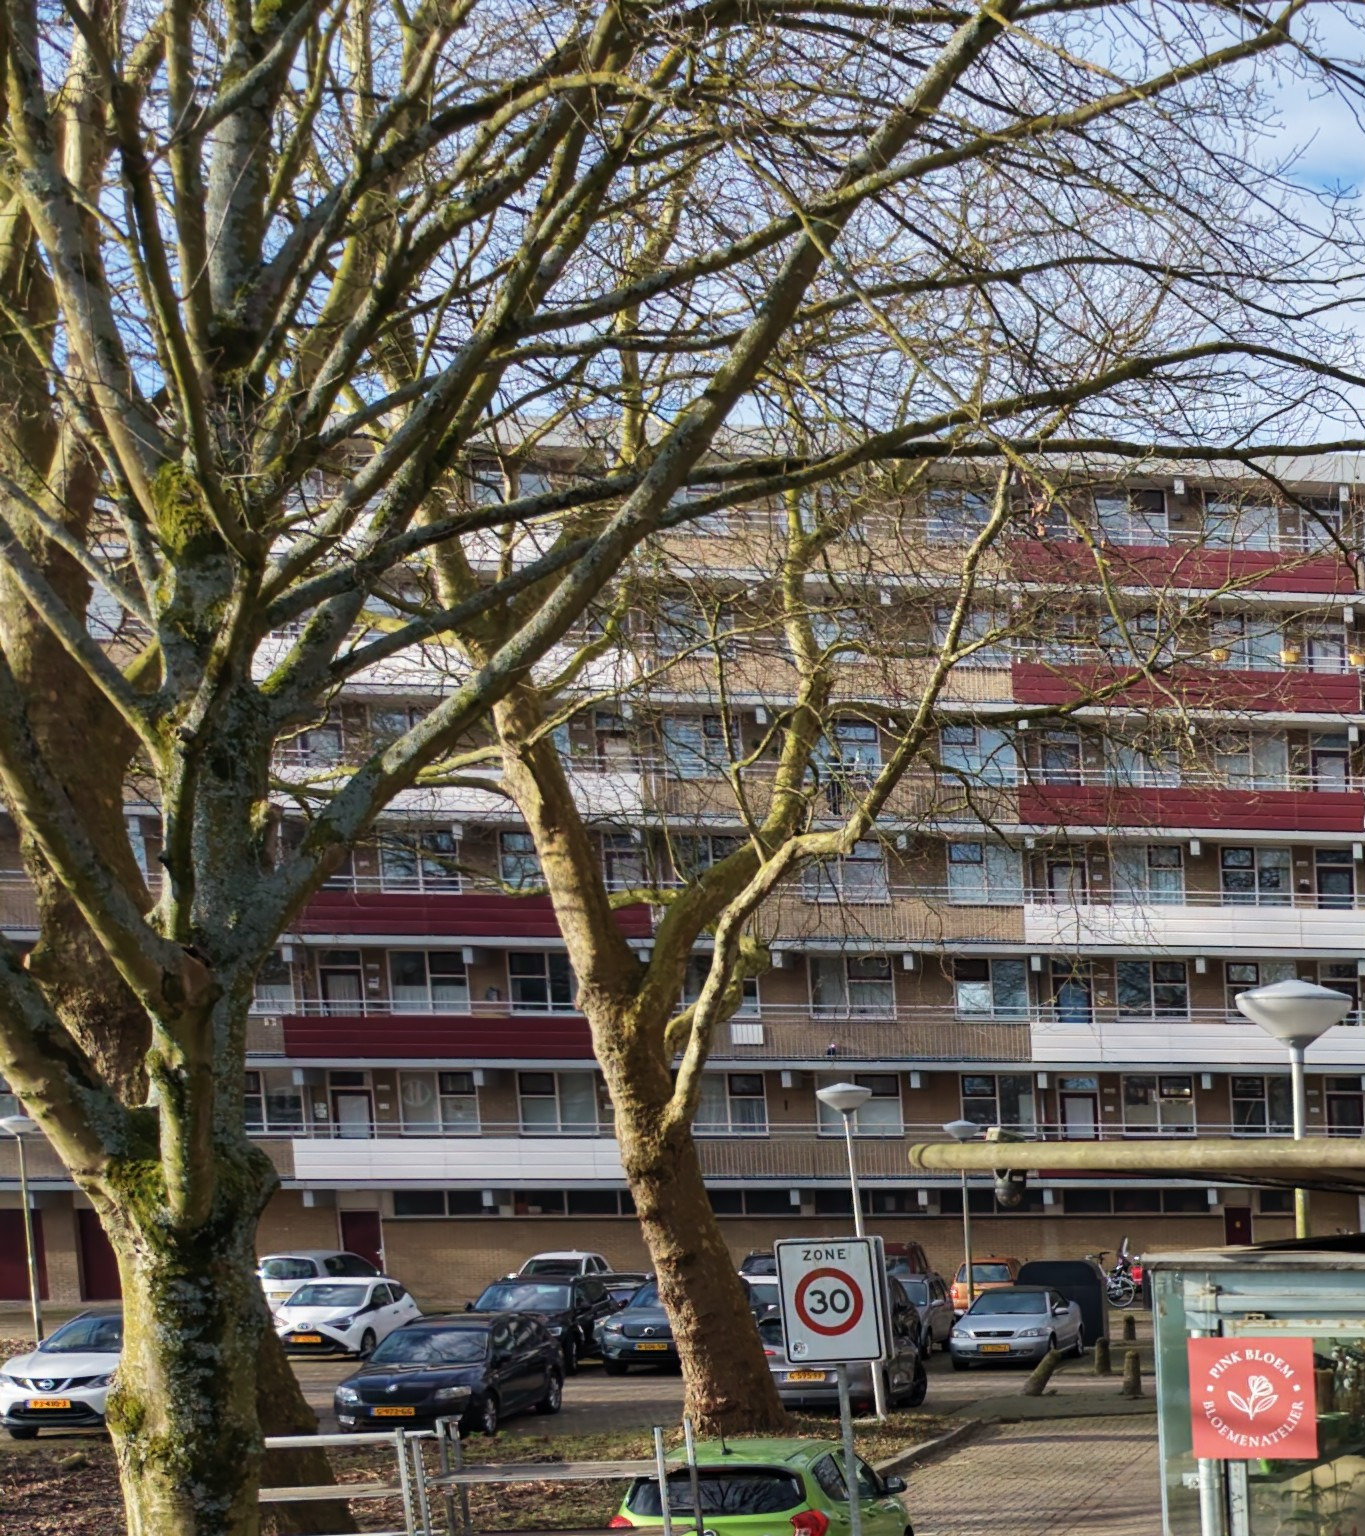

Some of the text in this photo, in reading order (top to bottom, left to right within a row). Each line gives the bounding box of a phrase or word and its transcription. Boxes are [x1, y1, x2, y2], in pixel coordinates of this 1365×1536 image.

[802, 1248, 846, 1261] ZONE
[809, 1288, 850, 1315] 30
[1208, 1348, 1295, 1379] PINK BLOEM
[1202, 1400, 1305, 1448] BLOEMENATELIER
